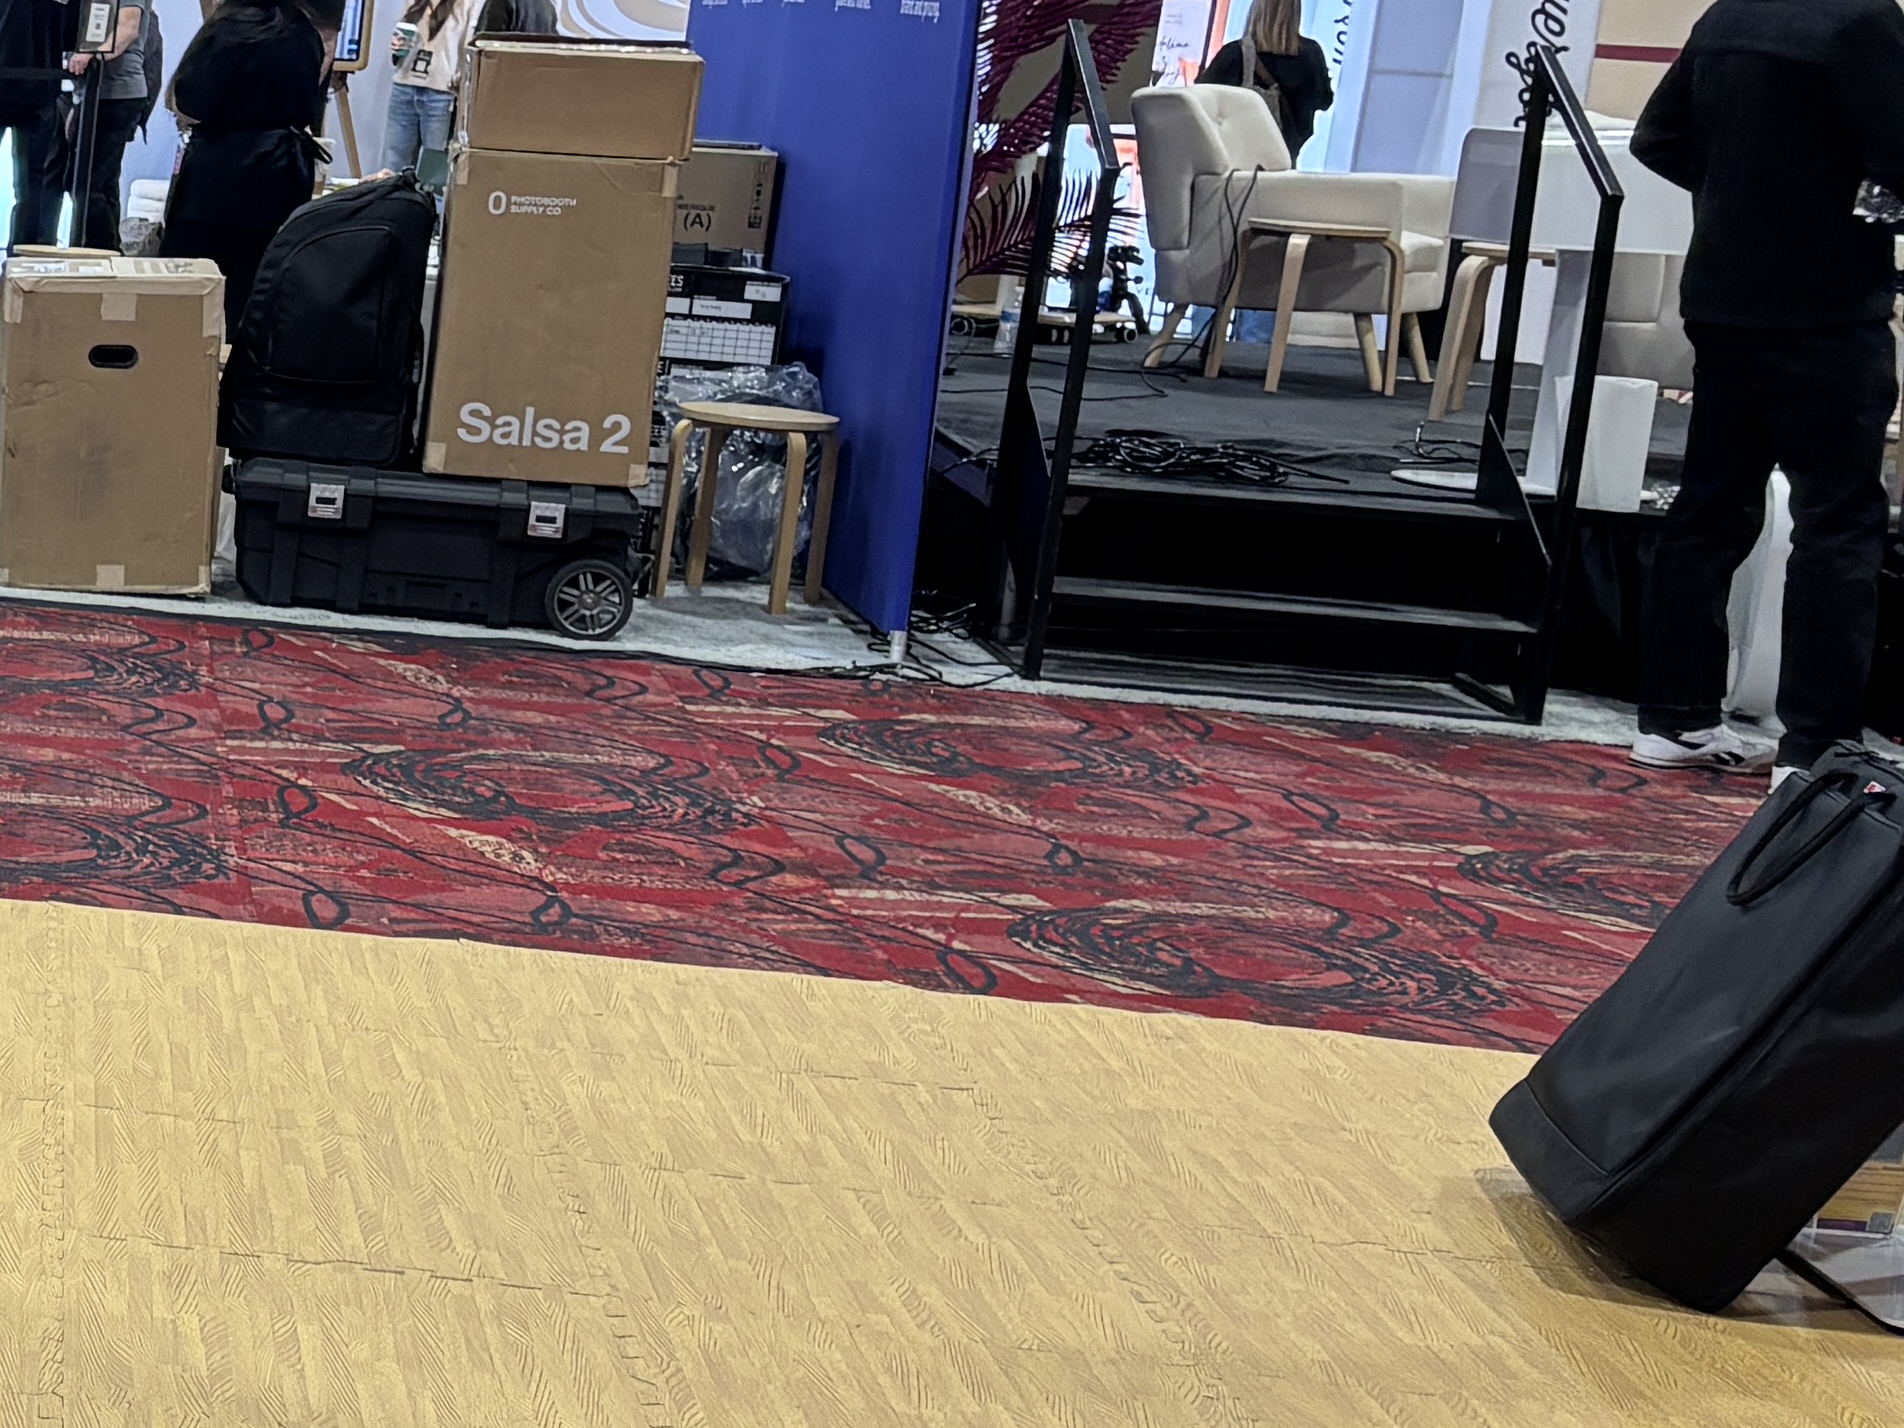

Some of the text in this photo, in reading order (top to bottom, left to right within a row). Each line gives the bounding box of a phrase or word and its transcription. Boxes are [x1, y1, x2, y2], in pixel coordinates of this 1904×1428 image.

[546, 207, 561, 215] CO
[683, 212, 712, 232] (A)
[457, 402, 631, 454] Salsa 2
